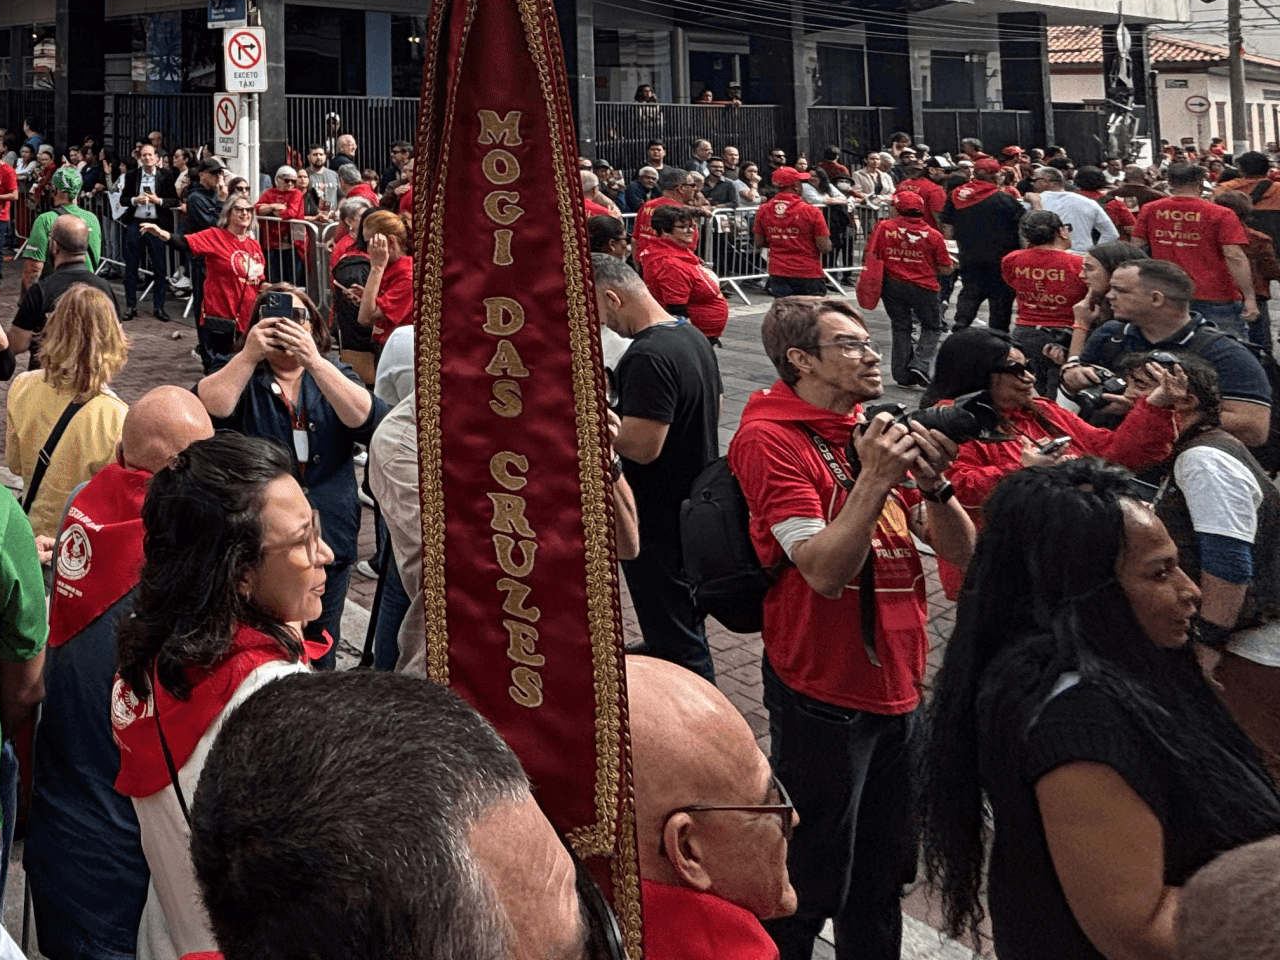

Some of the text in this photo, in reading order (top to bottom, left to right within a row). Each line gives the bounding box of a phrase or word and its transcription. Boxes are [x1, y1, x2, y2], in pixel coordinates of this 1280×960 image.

[233, 71, 259, 79] EXCETO
[1156, 209, 1201, 222] MOGI
[1155, 229, 1201, 240] DIVINO
[1015, 267, 1066, 281] MOGI
[477, 109, 546, 708] MOGI DAS CRUZES
[813, 435, 847, 481] EOS 60D
